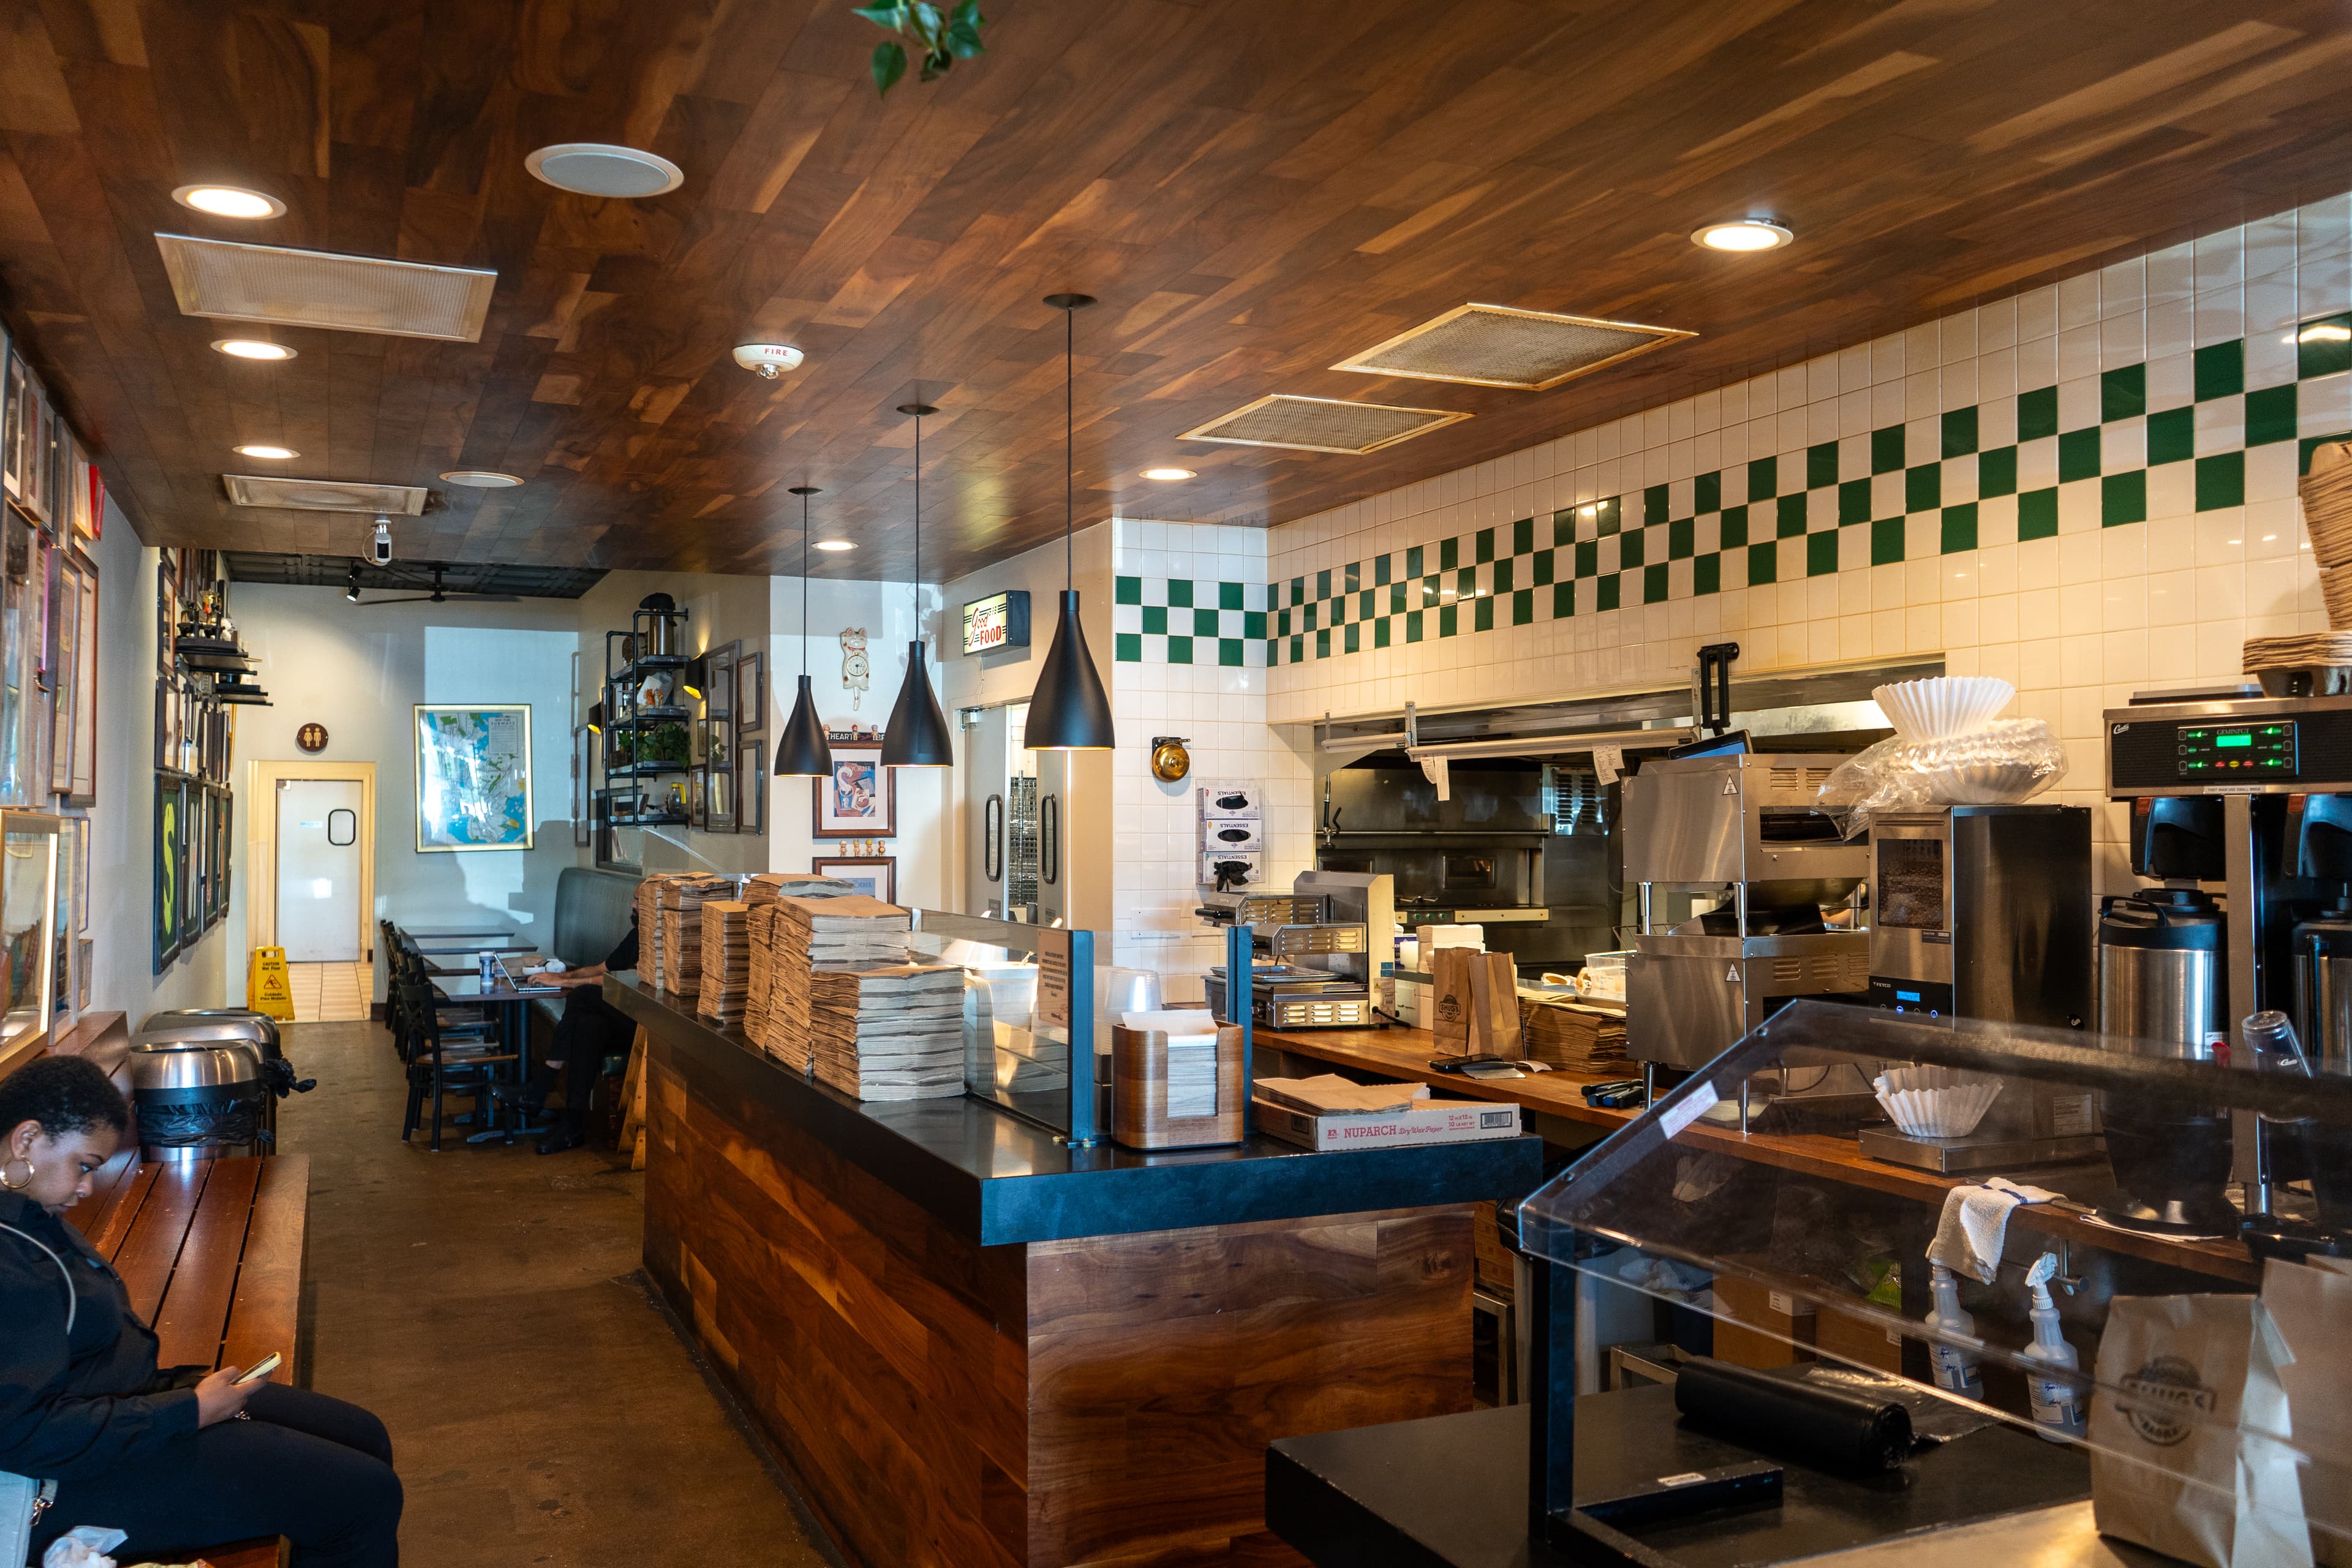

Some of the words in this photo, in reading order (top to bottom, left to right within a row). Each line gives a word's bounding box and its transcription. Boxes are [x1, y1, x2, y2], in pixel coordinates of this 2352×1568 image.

[764, 348, 788, 356] FIRE
[968, 608, 989, 647] Good
[980, 626, 1002, 646] FOOD
[2113, 723, 2130, 734] Curtis
[1441, 1004, 1458, 1012] SHUG'S
[1344, 1125, 1397, 1138] NUPARCH
